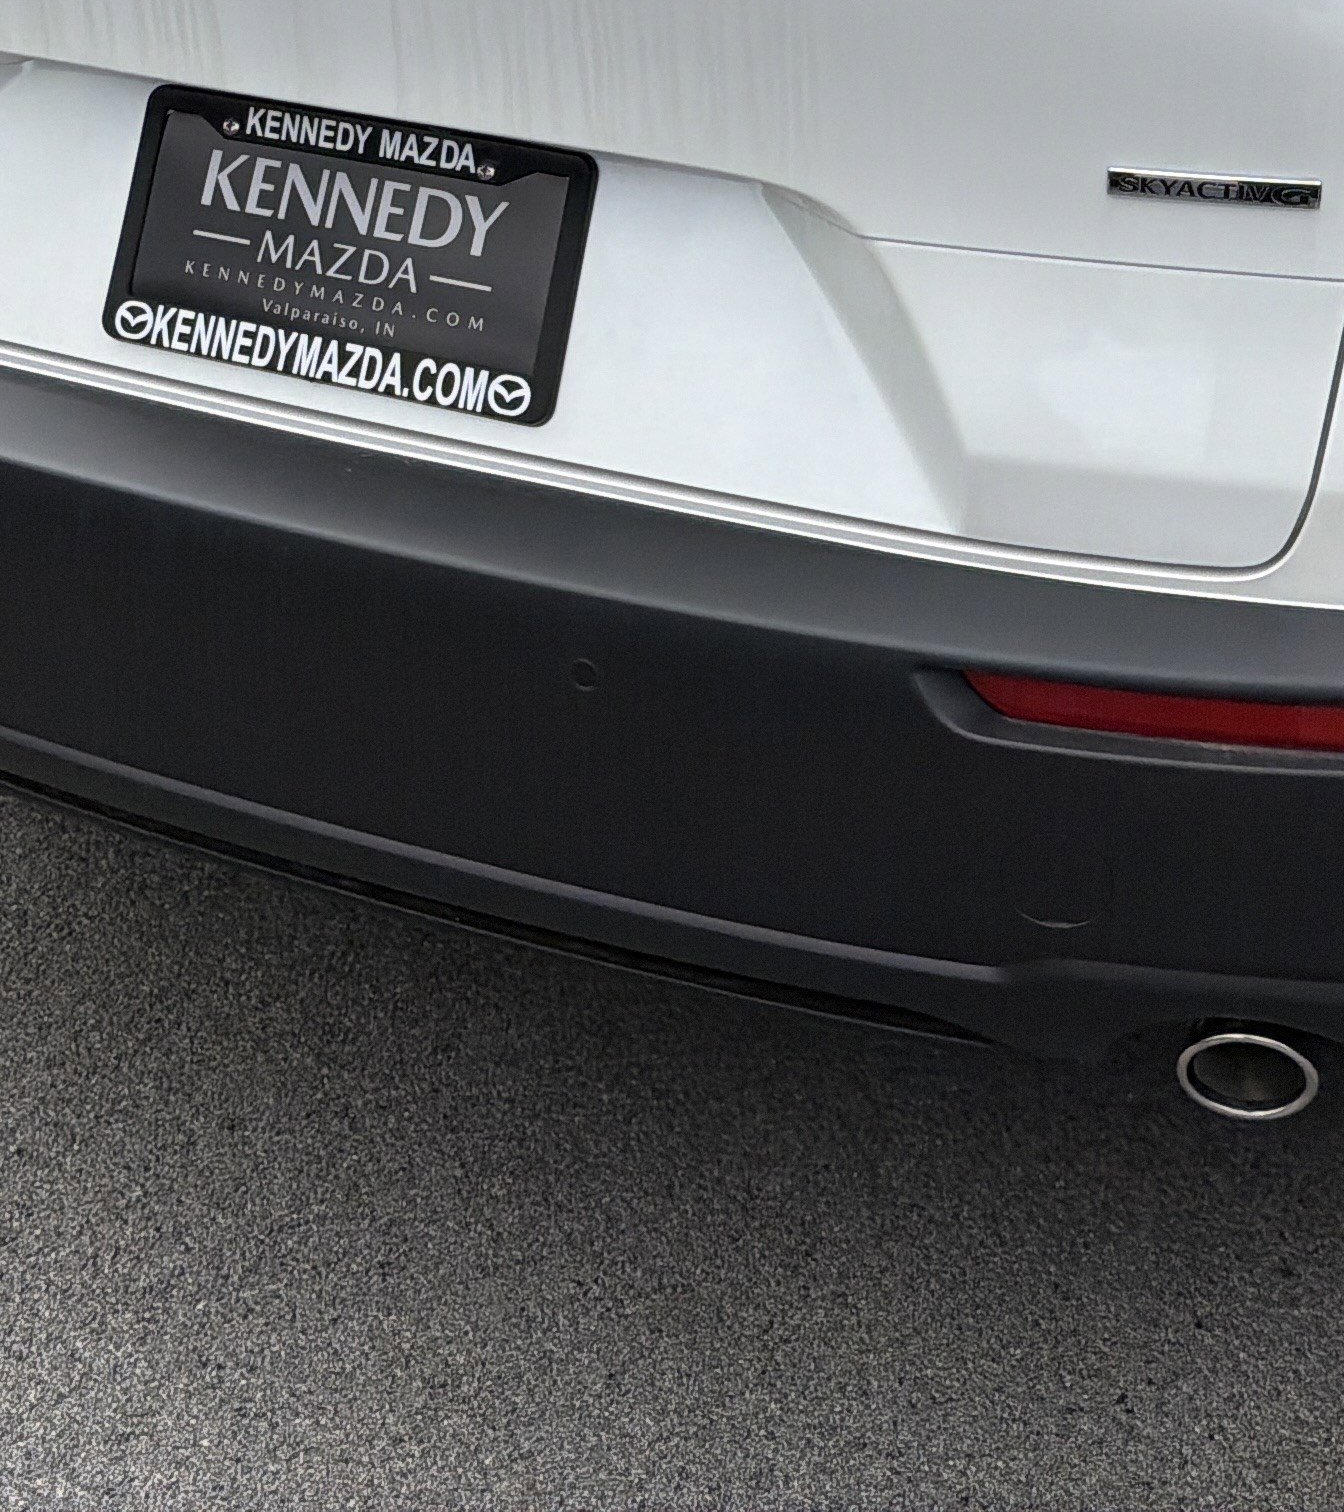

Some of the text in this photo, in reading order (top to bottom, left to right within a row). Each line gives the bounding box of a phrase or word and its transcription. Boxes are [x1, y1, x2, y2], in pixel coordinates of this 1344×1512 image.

[245, 106, 478, 174] KENNEDY MAZDA
[199, 148, 511, 257] KENNEDY
[184, 259, 486, 333] KENNEDYMAZDA.COM
[256, 229, 419, 294] MAZDA
[261, 297, 397, 338] Valparaiso, IN
[150, 304, 491, 414] KENNEDYMAZDA.COM
